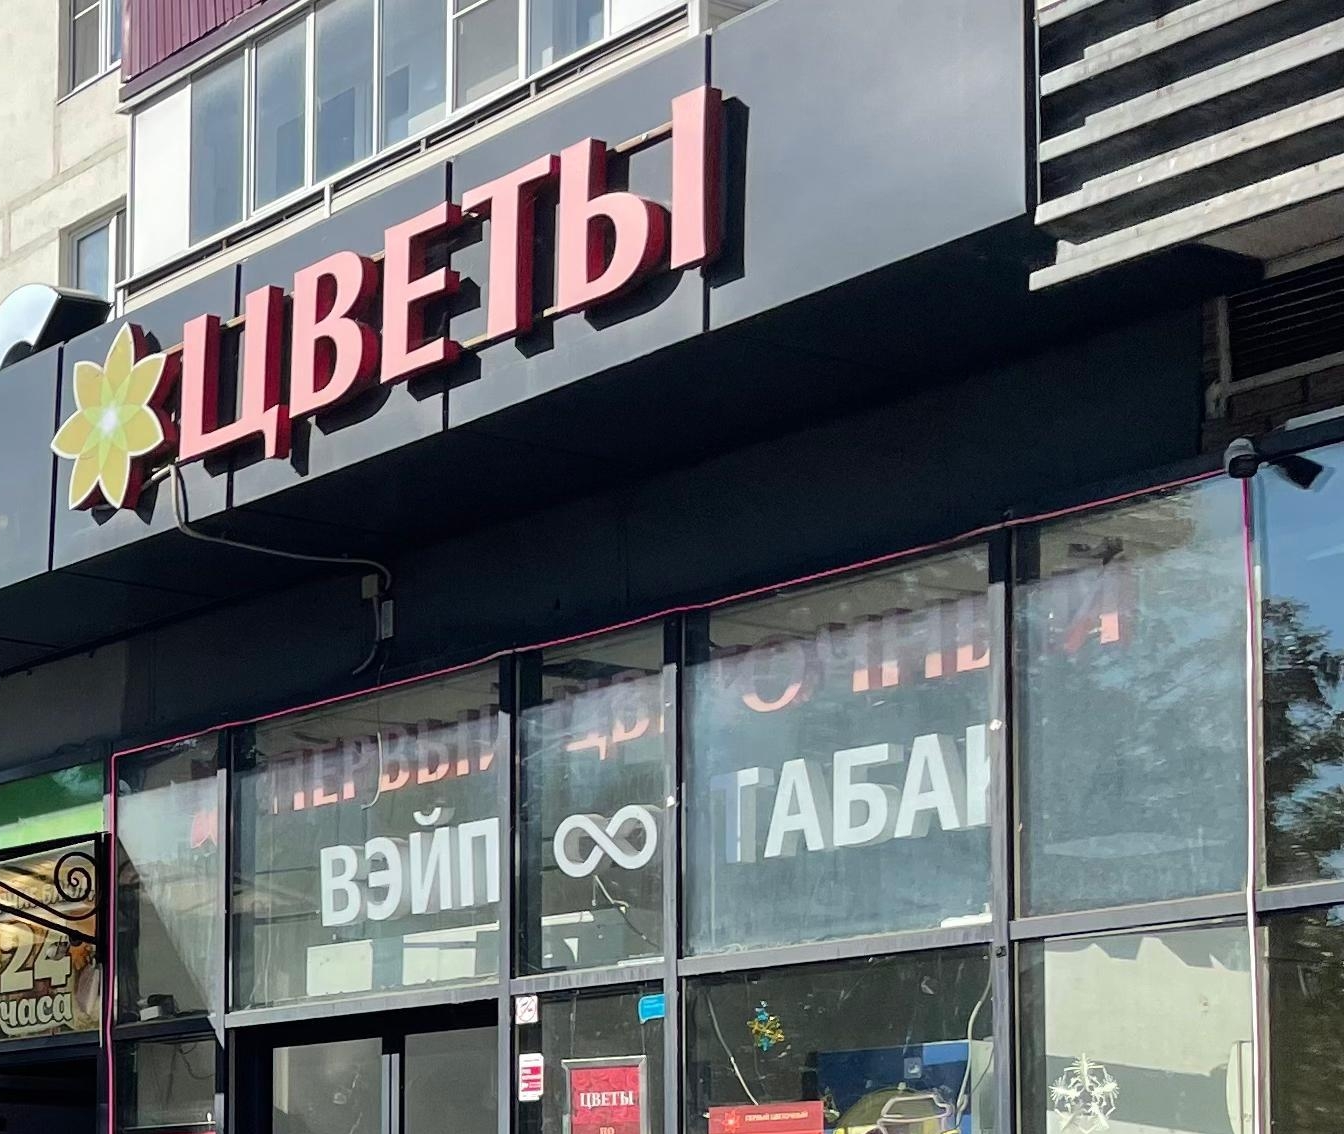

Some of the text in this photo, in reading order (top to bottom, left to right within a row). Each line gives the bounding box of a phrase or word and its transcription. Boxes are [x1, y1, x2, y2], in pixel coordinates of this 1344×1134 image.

[178, 86, 720, 463] ЦВЕТЫ
[320, 806, 500, 927] ВЭЙП
[0, 922, 72, 994] 24
[580, 1091, 634, 1109] ЦВЕТЫ
